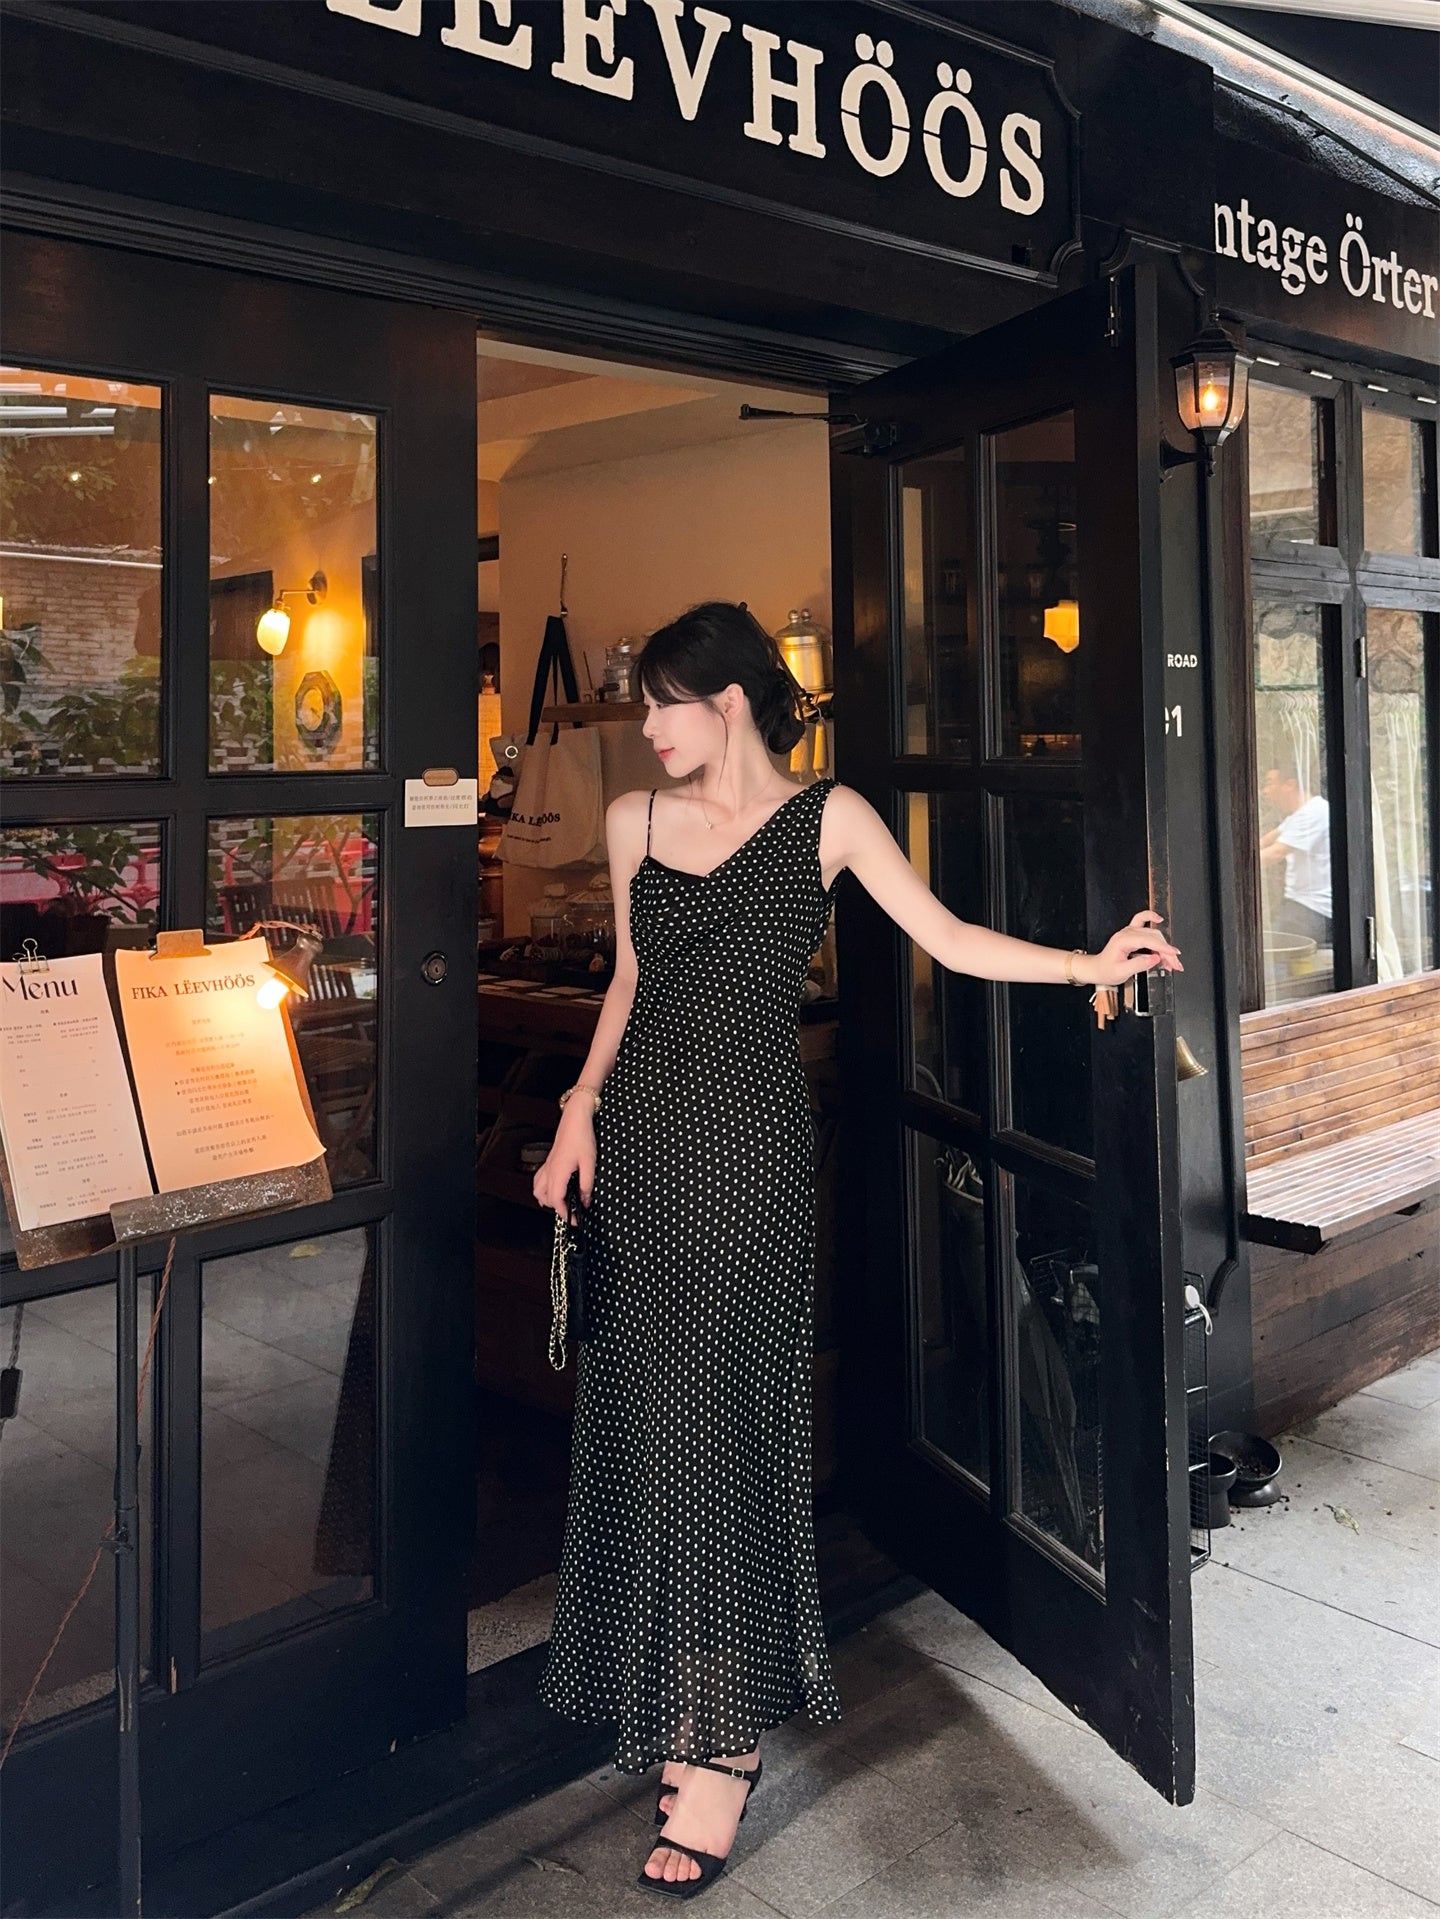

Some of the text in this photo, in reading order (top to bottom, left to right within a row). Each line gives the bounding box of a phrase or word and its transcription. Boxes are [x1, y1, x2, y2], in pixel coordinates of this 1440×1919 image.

[326, 0, 1045, 216] EVHÖÖS
[1340, 212, 1438, 319] Örter
[1167, 653, 1198, 668] ROAD
[2, 975, 79, 1002] Menu
[131, 973, 256, 1000] FIKA LËEVHÖÖS
